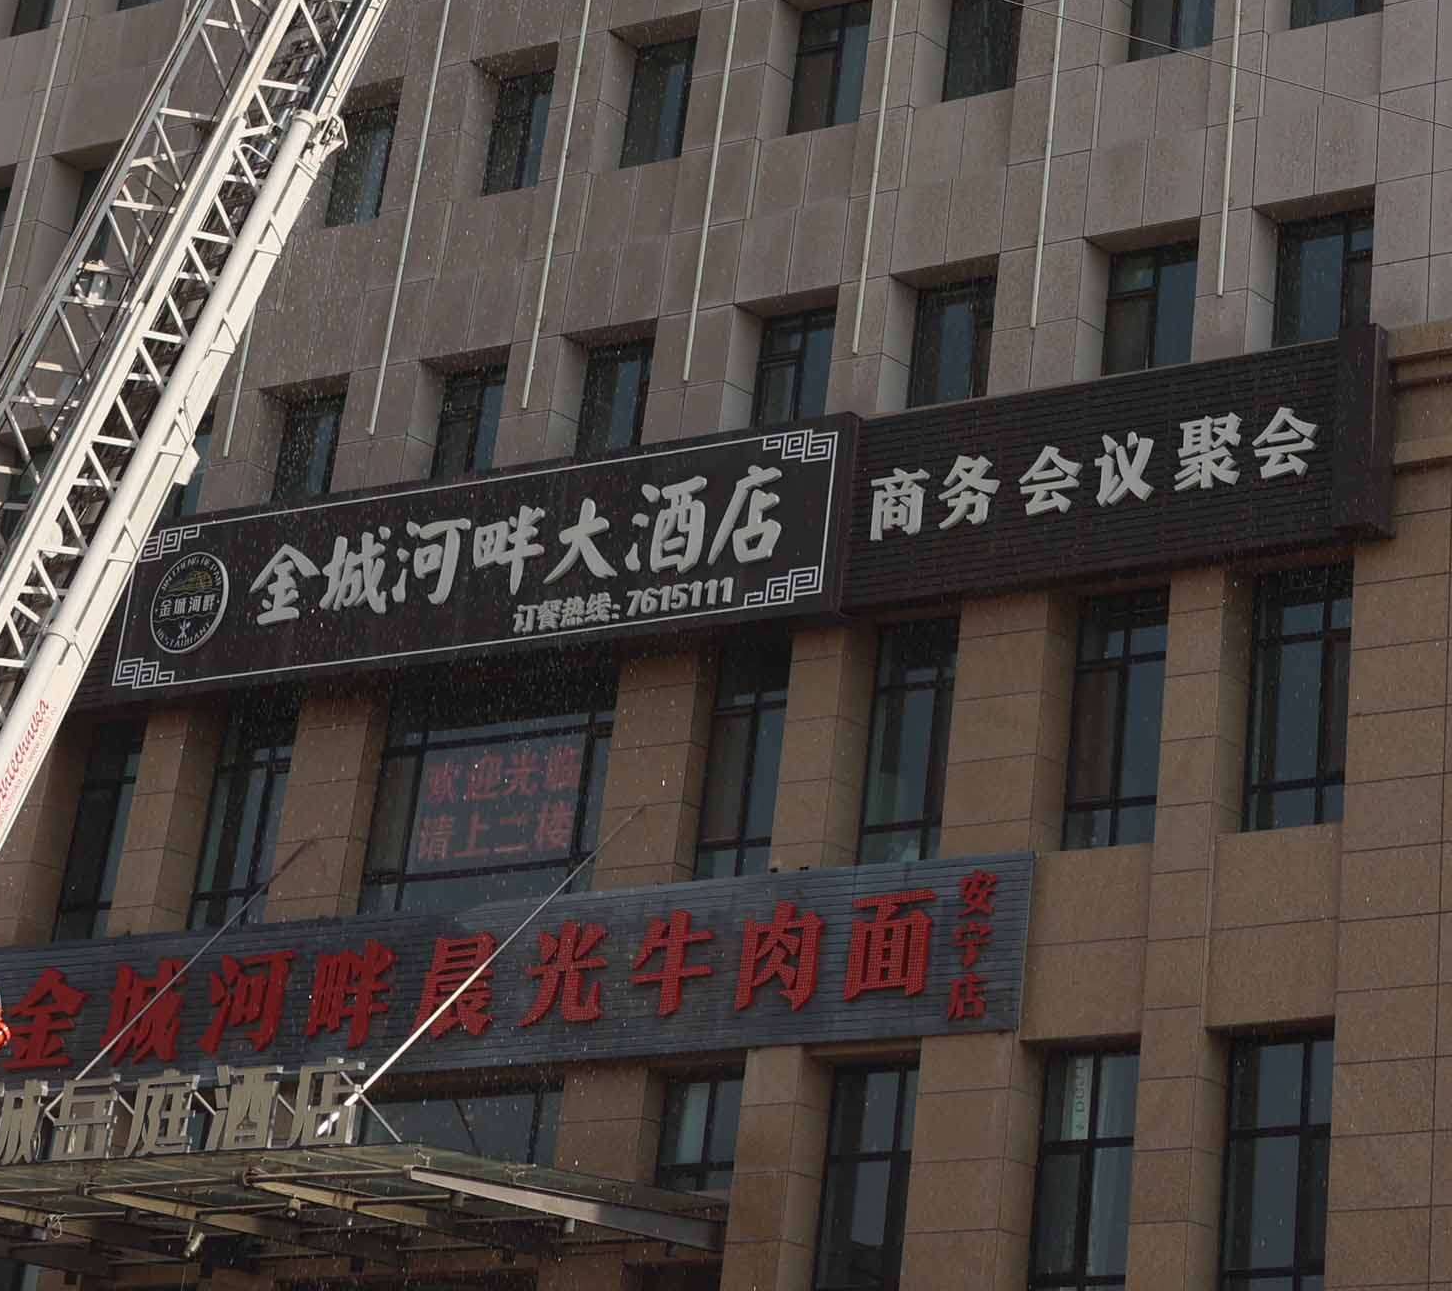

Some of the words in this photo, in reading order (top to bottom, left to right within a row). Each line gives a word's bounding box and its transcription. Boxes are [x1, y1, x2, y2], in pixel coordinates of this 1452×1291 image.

[250, 464, 784, 627] 金城河畔大酒店
[869, 405, 1319, 542] 商务会议聚会
[2, 888, 937, 1074] 金城河畔晨光牛肉面
[947, 868, 999, 1022] 安宁店
